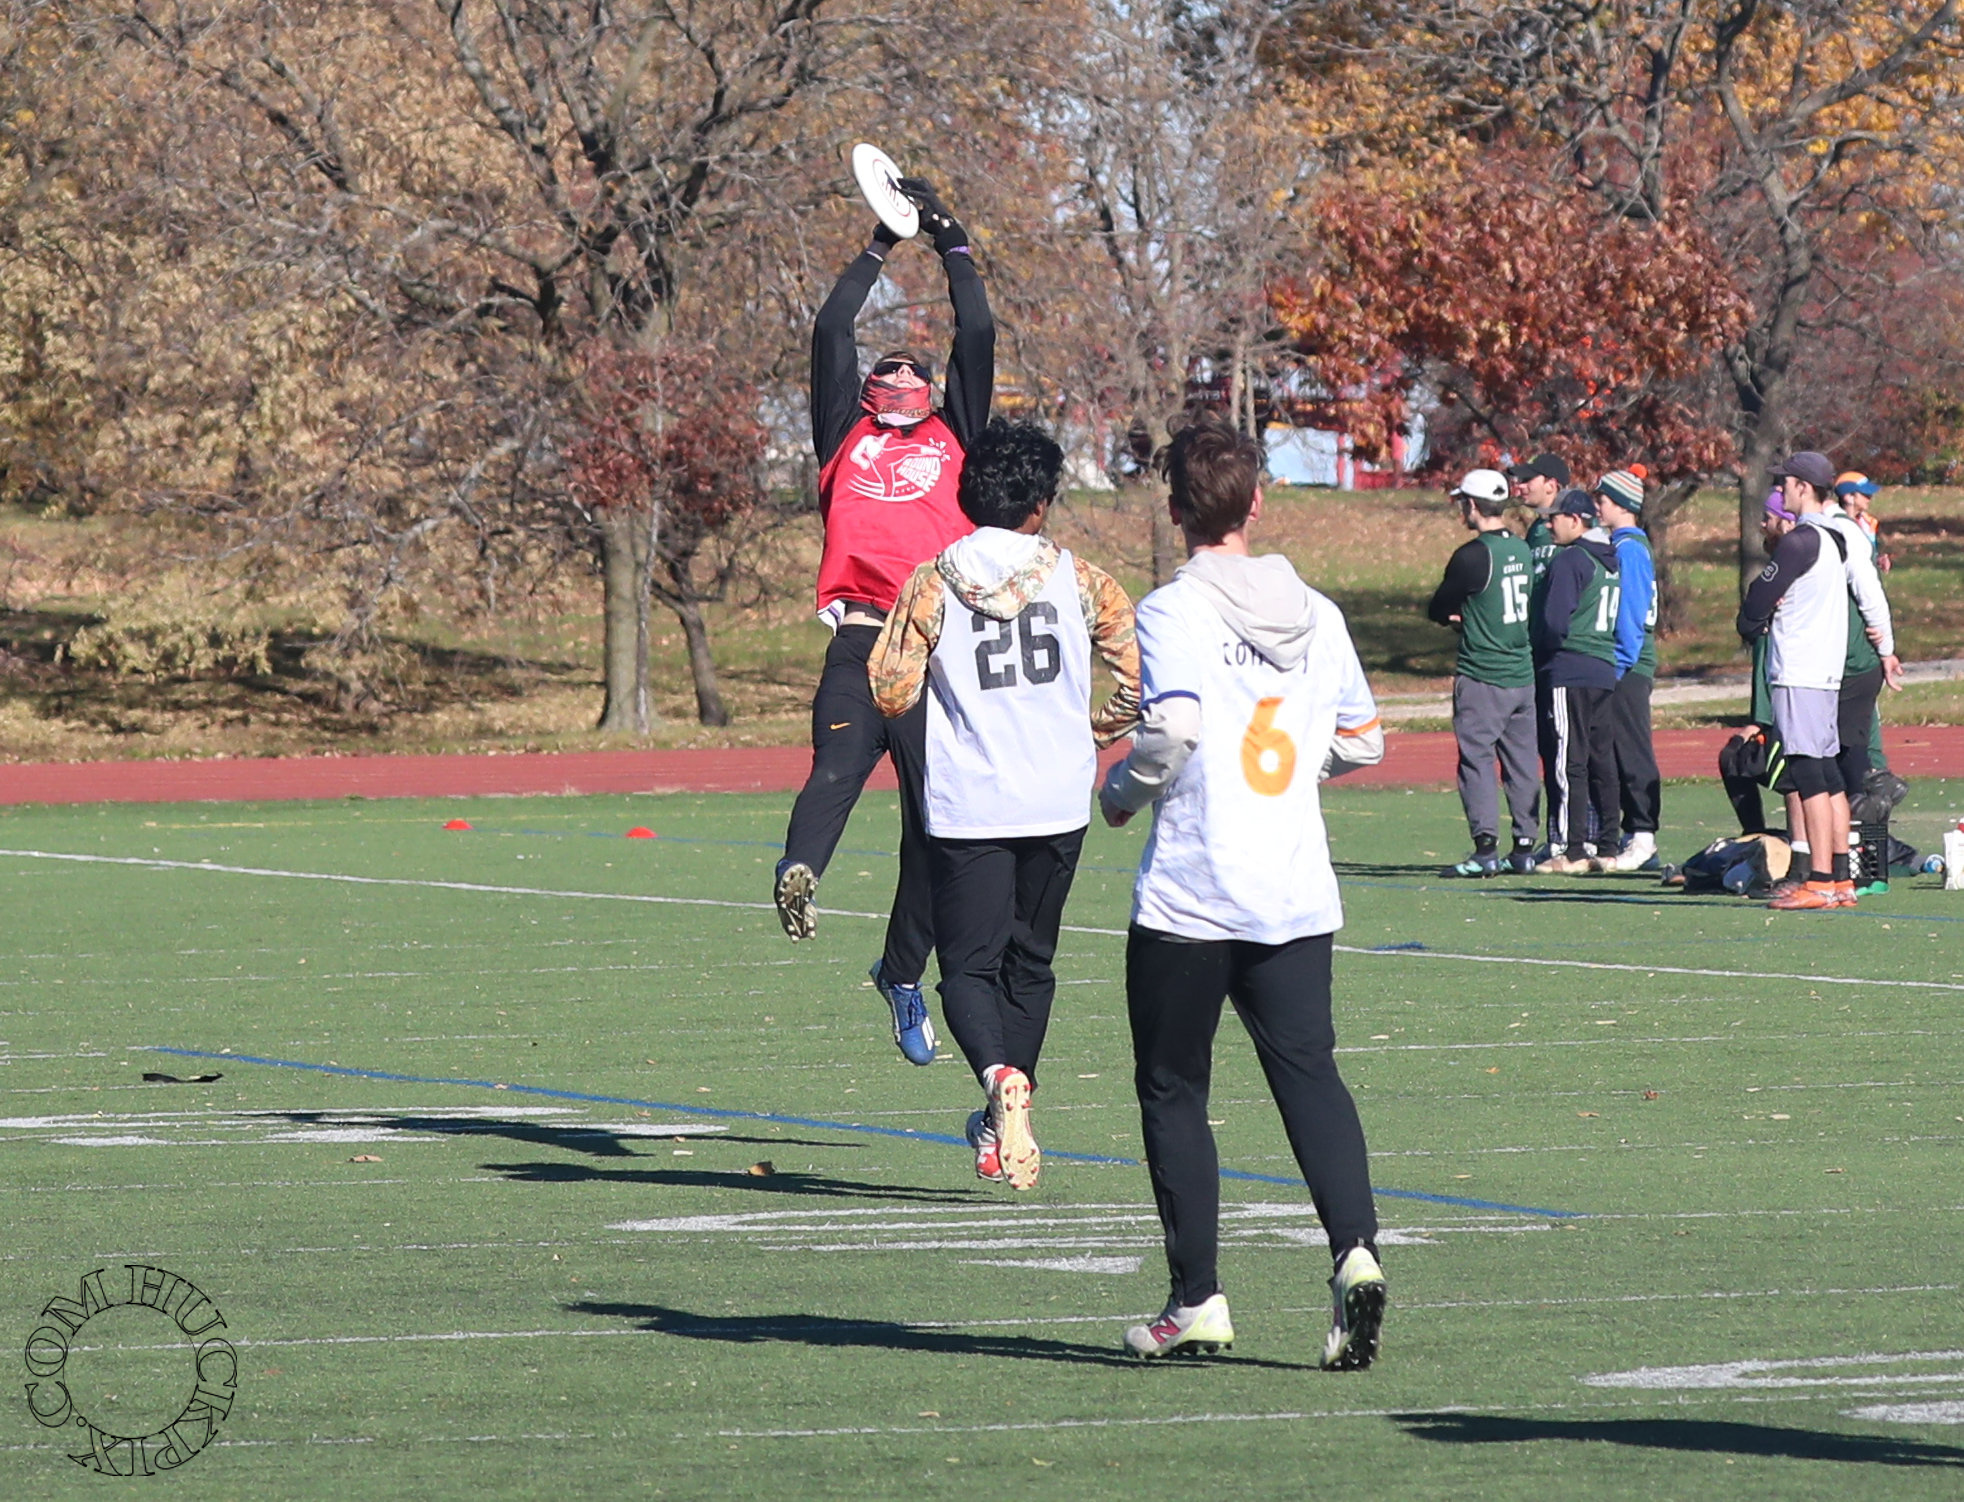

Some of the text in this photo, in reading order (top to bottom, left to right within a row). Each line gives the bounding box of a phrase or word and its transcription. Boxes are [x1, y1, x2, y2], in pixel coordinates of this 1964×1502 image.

[1501, 574, 1529, 625] 15
[971, 601, 1061, 691] 26
[1240, 696, 1297, 796] 6
